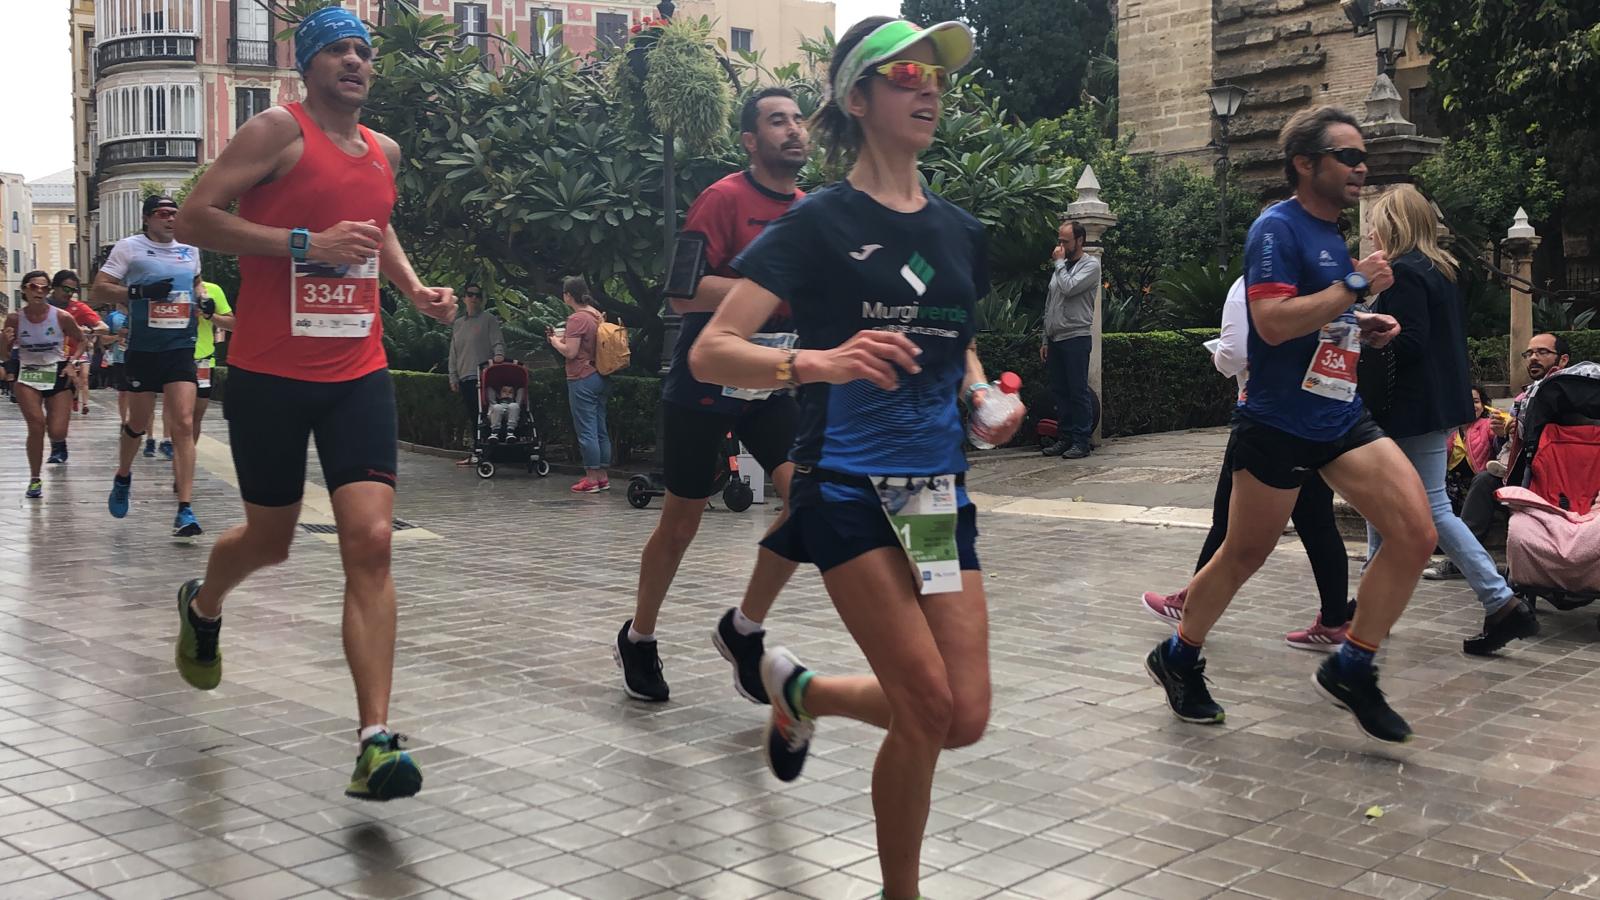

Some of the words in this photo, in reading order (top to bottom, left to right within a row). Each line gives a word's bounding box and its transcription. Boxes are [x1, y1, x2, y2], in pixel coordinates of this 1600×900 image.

[303, 283, 357, 303] 3347
[153, 305, 180, 314] 4545
[861, 301, 968, 323] Murgiverde
